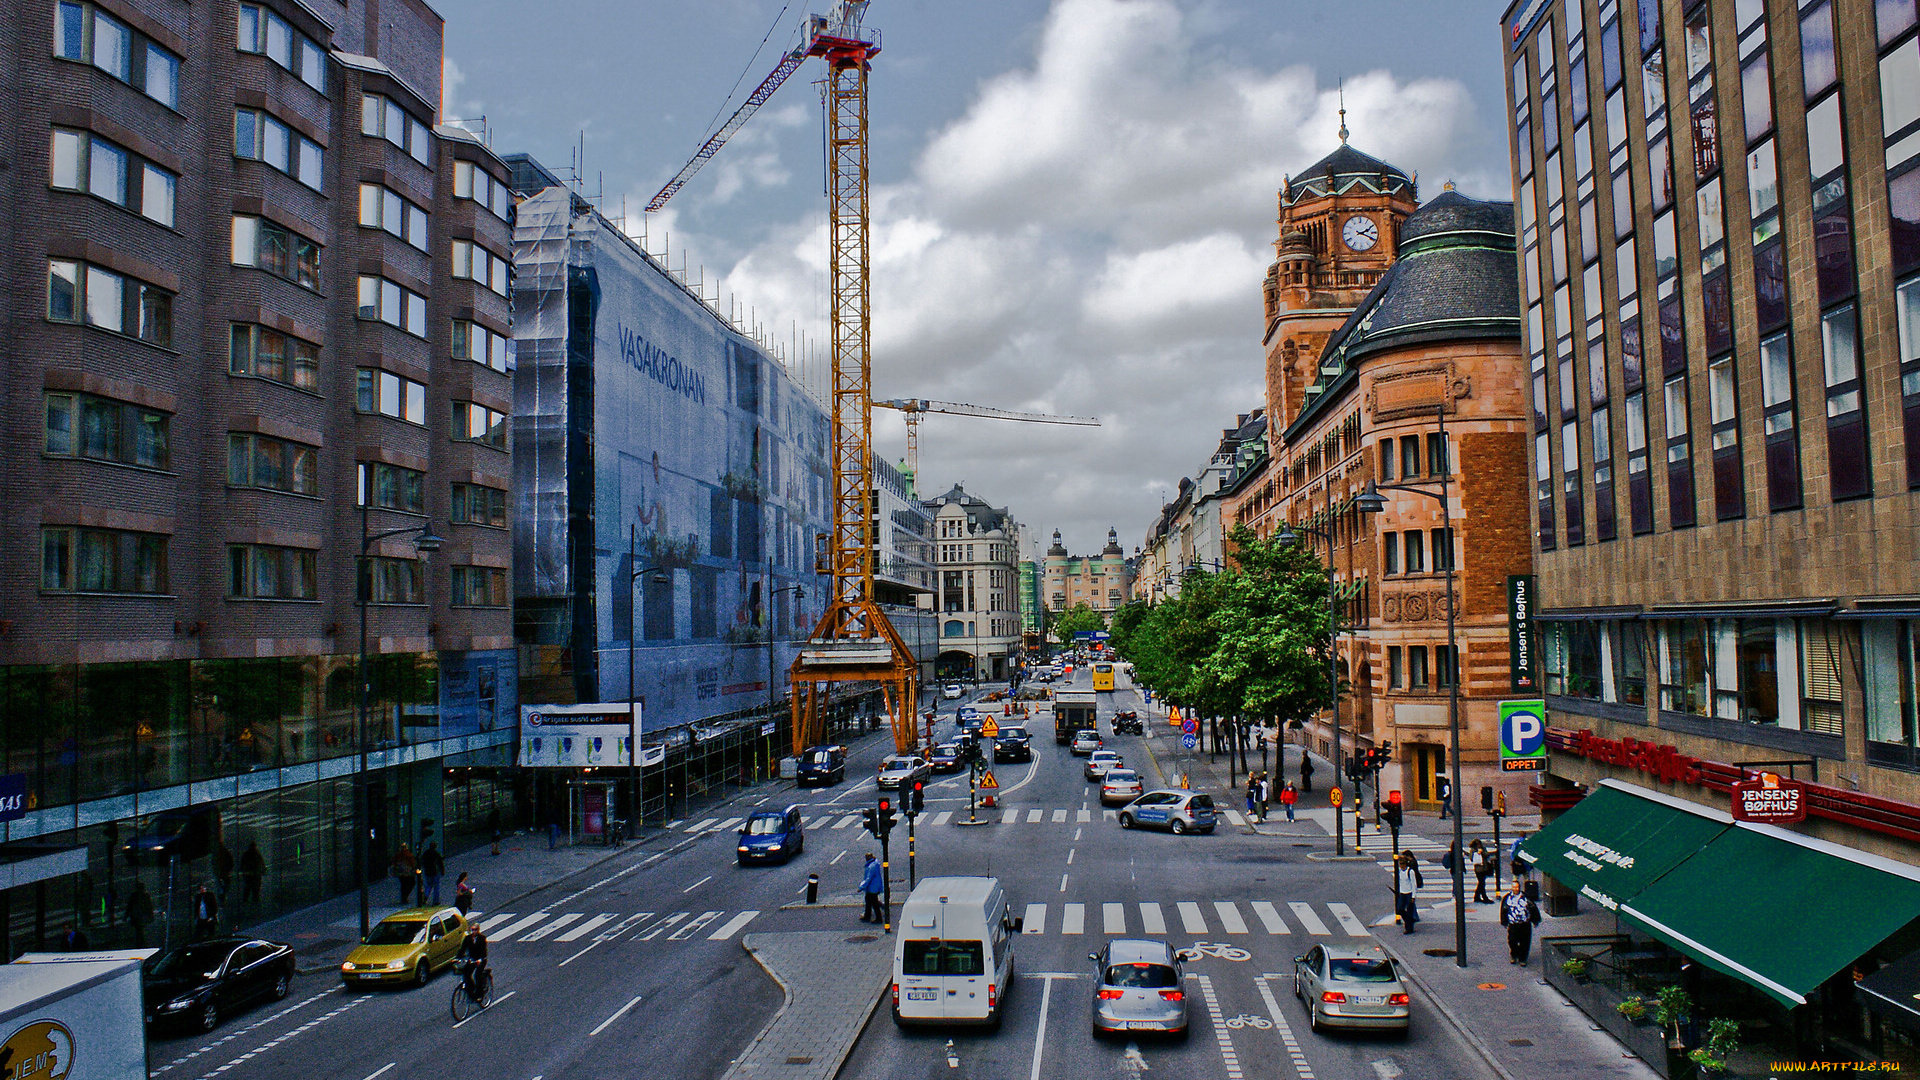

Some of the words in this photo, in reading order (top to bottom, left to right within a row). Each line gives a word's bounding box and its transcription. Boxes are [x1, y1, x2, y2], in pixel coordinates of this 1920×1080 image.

[617, 321, 705, 407] VASAKRONAN
[1515, 580, 1527, 620] Bøfhus
[1512, 715, 1541, 751] P
[0, 795, 23, 813] SAS
[1332, 792, 1341, 802] 30
[1741, 789, 1800, 801] JENSEN'S
[1744, 801, 1798, 812] BØFHUS
